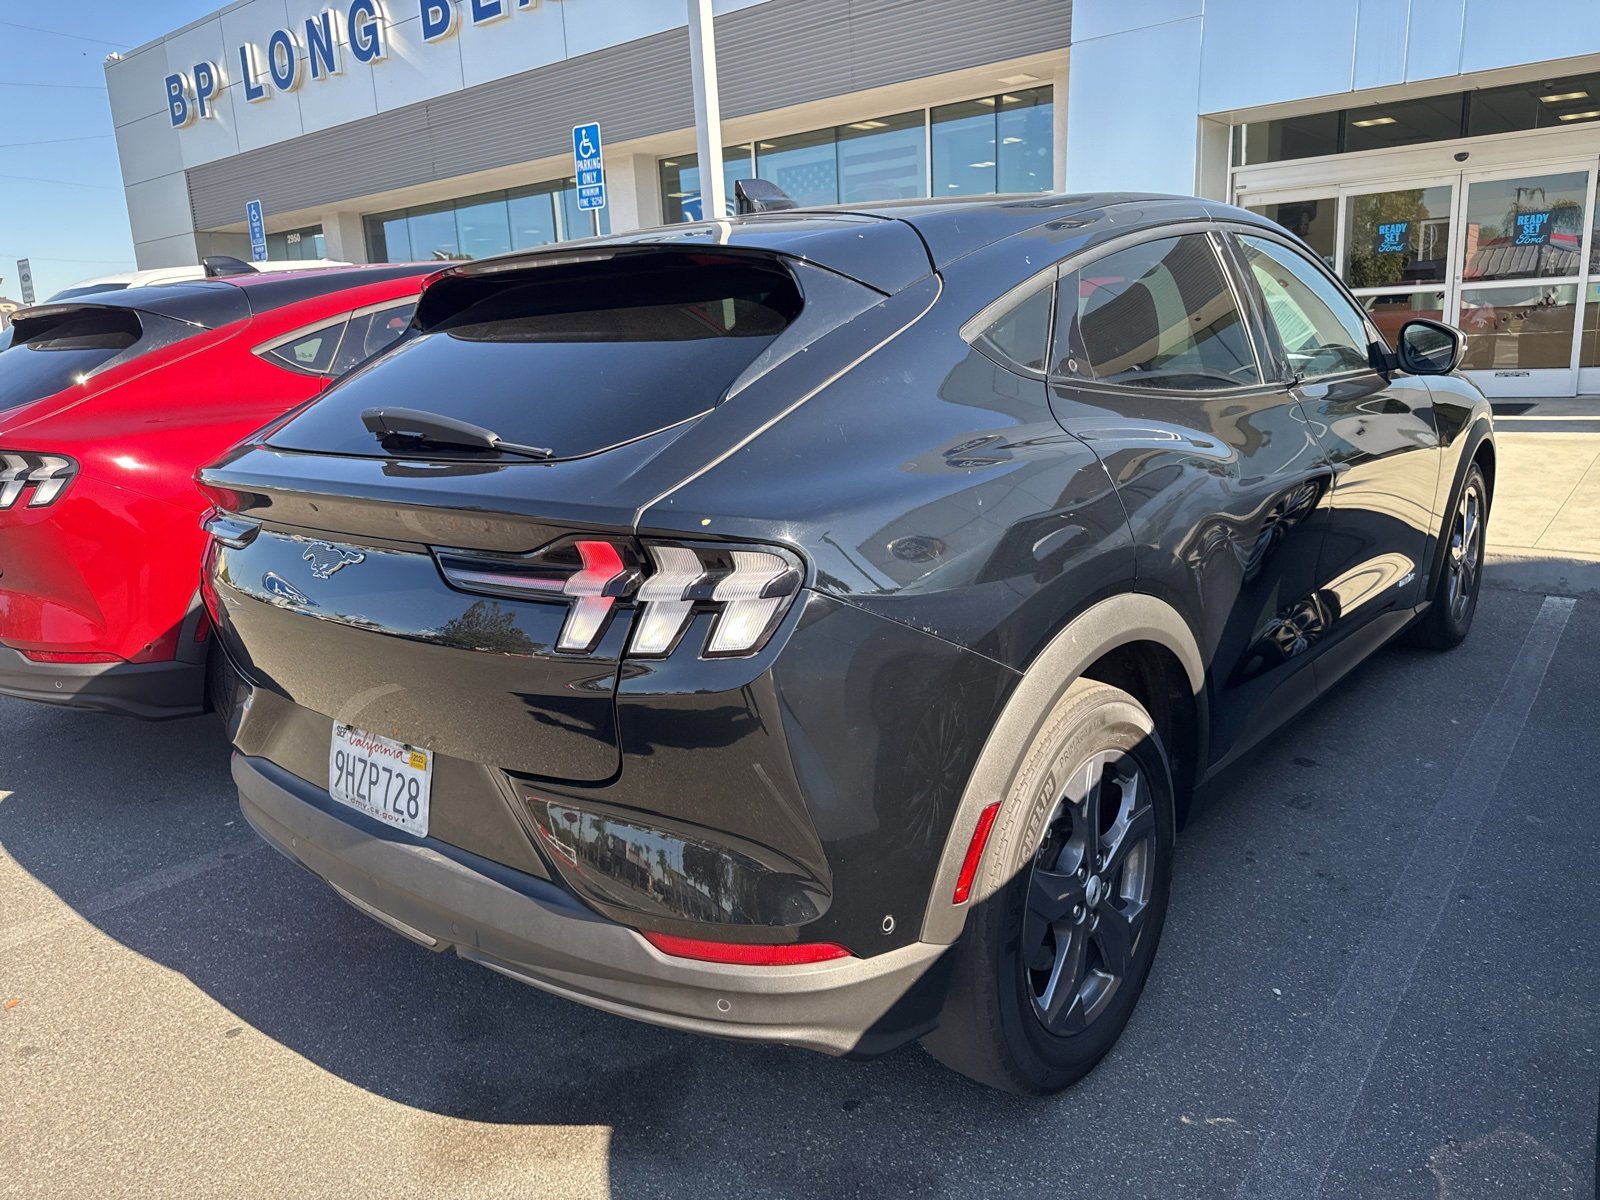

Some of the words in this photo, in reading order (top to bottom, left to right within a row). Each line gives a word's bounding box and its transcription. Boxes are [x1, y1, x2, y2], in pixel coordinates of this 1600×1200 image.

[164, 61, 216, 129] BP
[239, 0, 384, 102] LONG
[577, 157, 601, 172] PARKING
[582, 172, 597, 184] ONLY
[1516, 213, 1549, 225] READY
[1379, 223, 1407, 235] READY
[1522, 224, 1541, 235] SET
[286, 233, 301, 244] 2950
[1384, 233, 1400, 242] SET
[1515, 234, 1547, 244] Ford
[1378, 242, 1407, 252] Ford
[349, 728, 406, 761] California
[335, 750, 420, 820] 9HZP728
[351, 798, 400, 822] dmv.ca.gov
[1019, 776, 1055, 868] CHELIN
